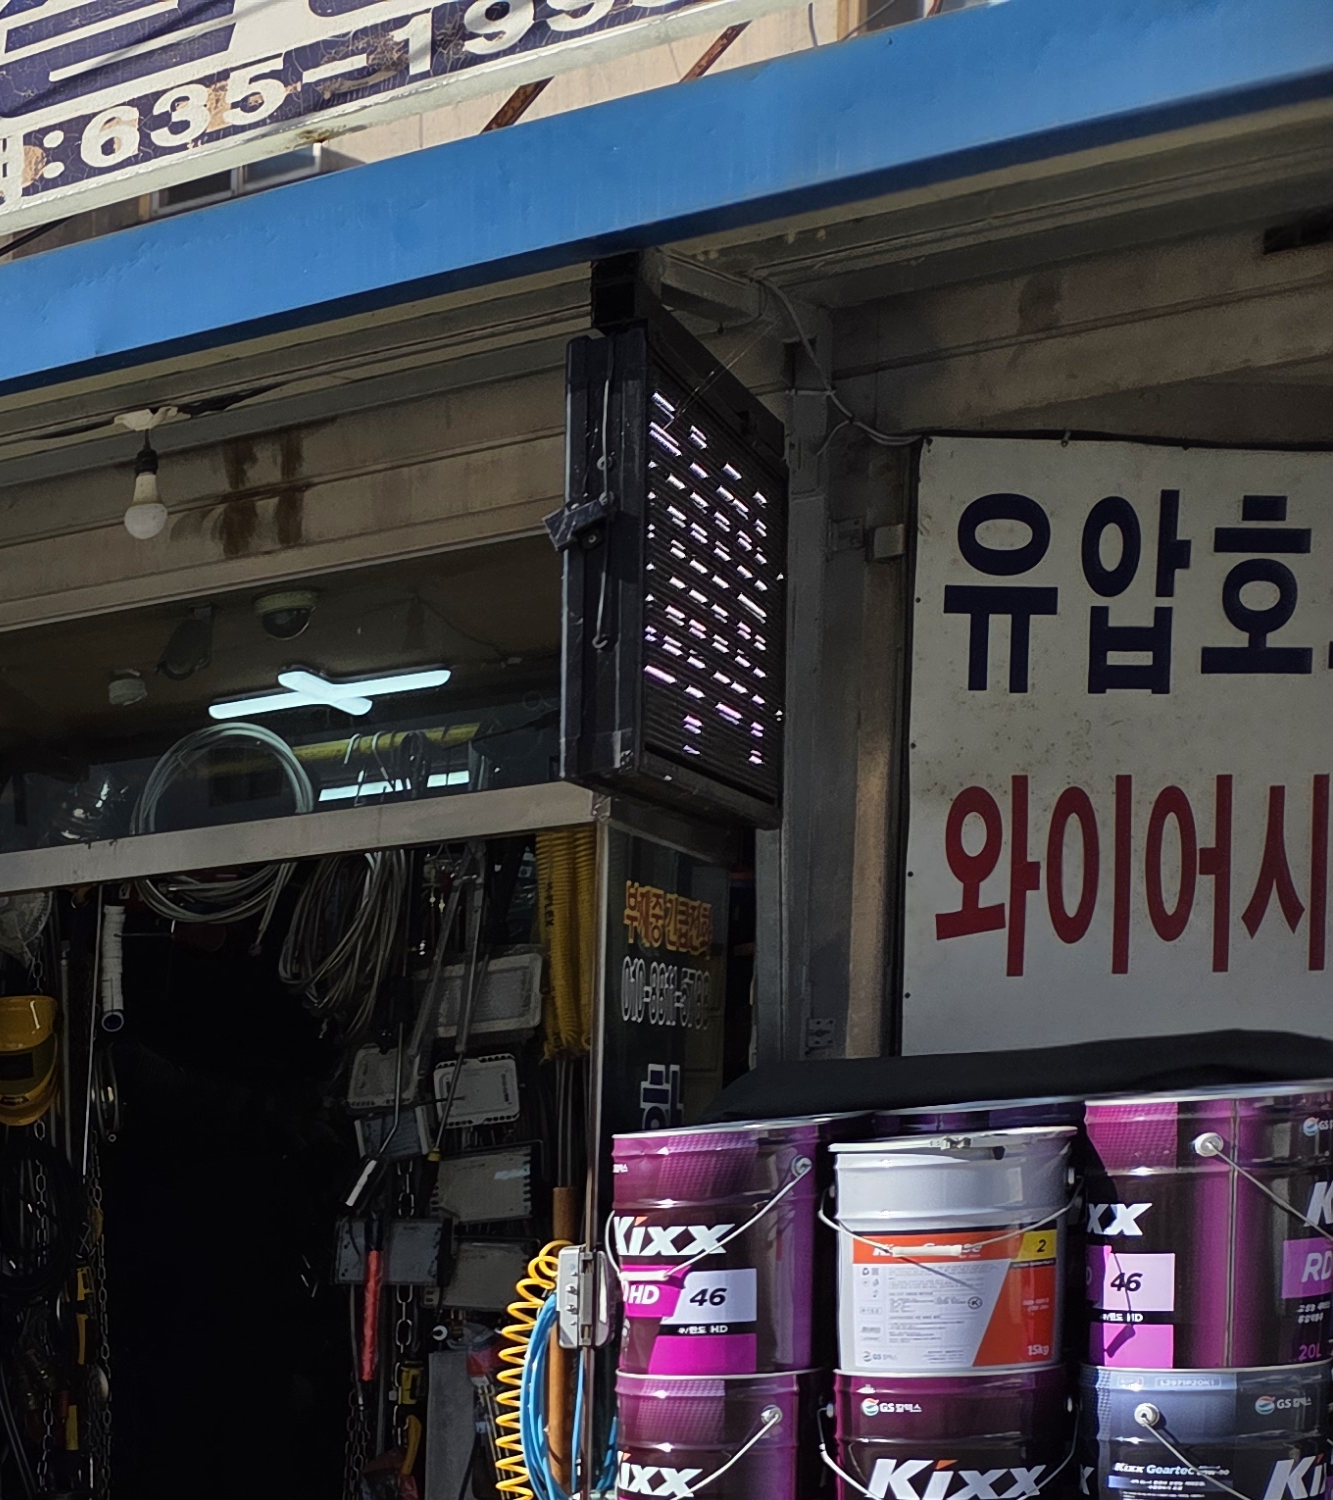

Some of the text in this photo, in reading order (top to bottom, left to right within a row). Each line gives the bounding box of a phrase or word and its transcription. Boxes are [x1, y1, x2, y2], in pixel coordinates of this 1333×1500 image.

[943, 489, 1333, 694] 유압호
[1086, 1202, 1153, 1236] xx
[1037, 1239, 1047, 1253] 2
[1110, 1272, 1144, 1292] 46
[629, 1284, 728, 1307] HD 46
[709, 1324, 729, 1334] HD
[1027, 1344, 1050, 1357] 15kg
[617, 1450, 703, 1498] ixx
[864, 1458, 1047, 1500] Kixx
